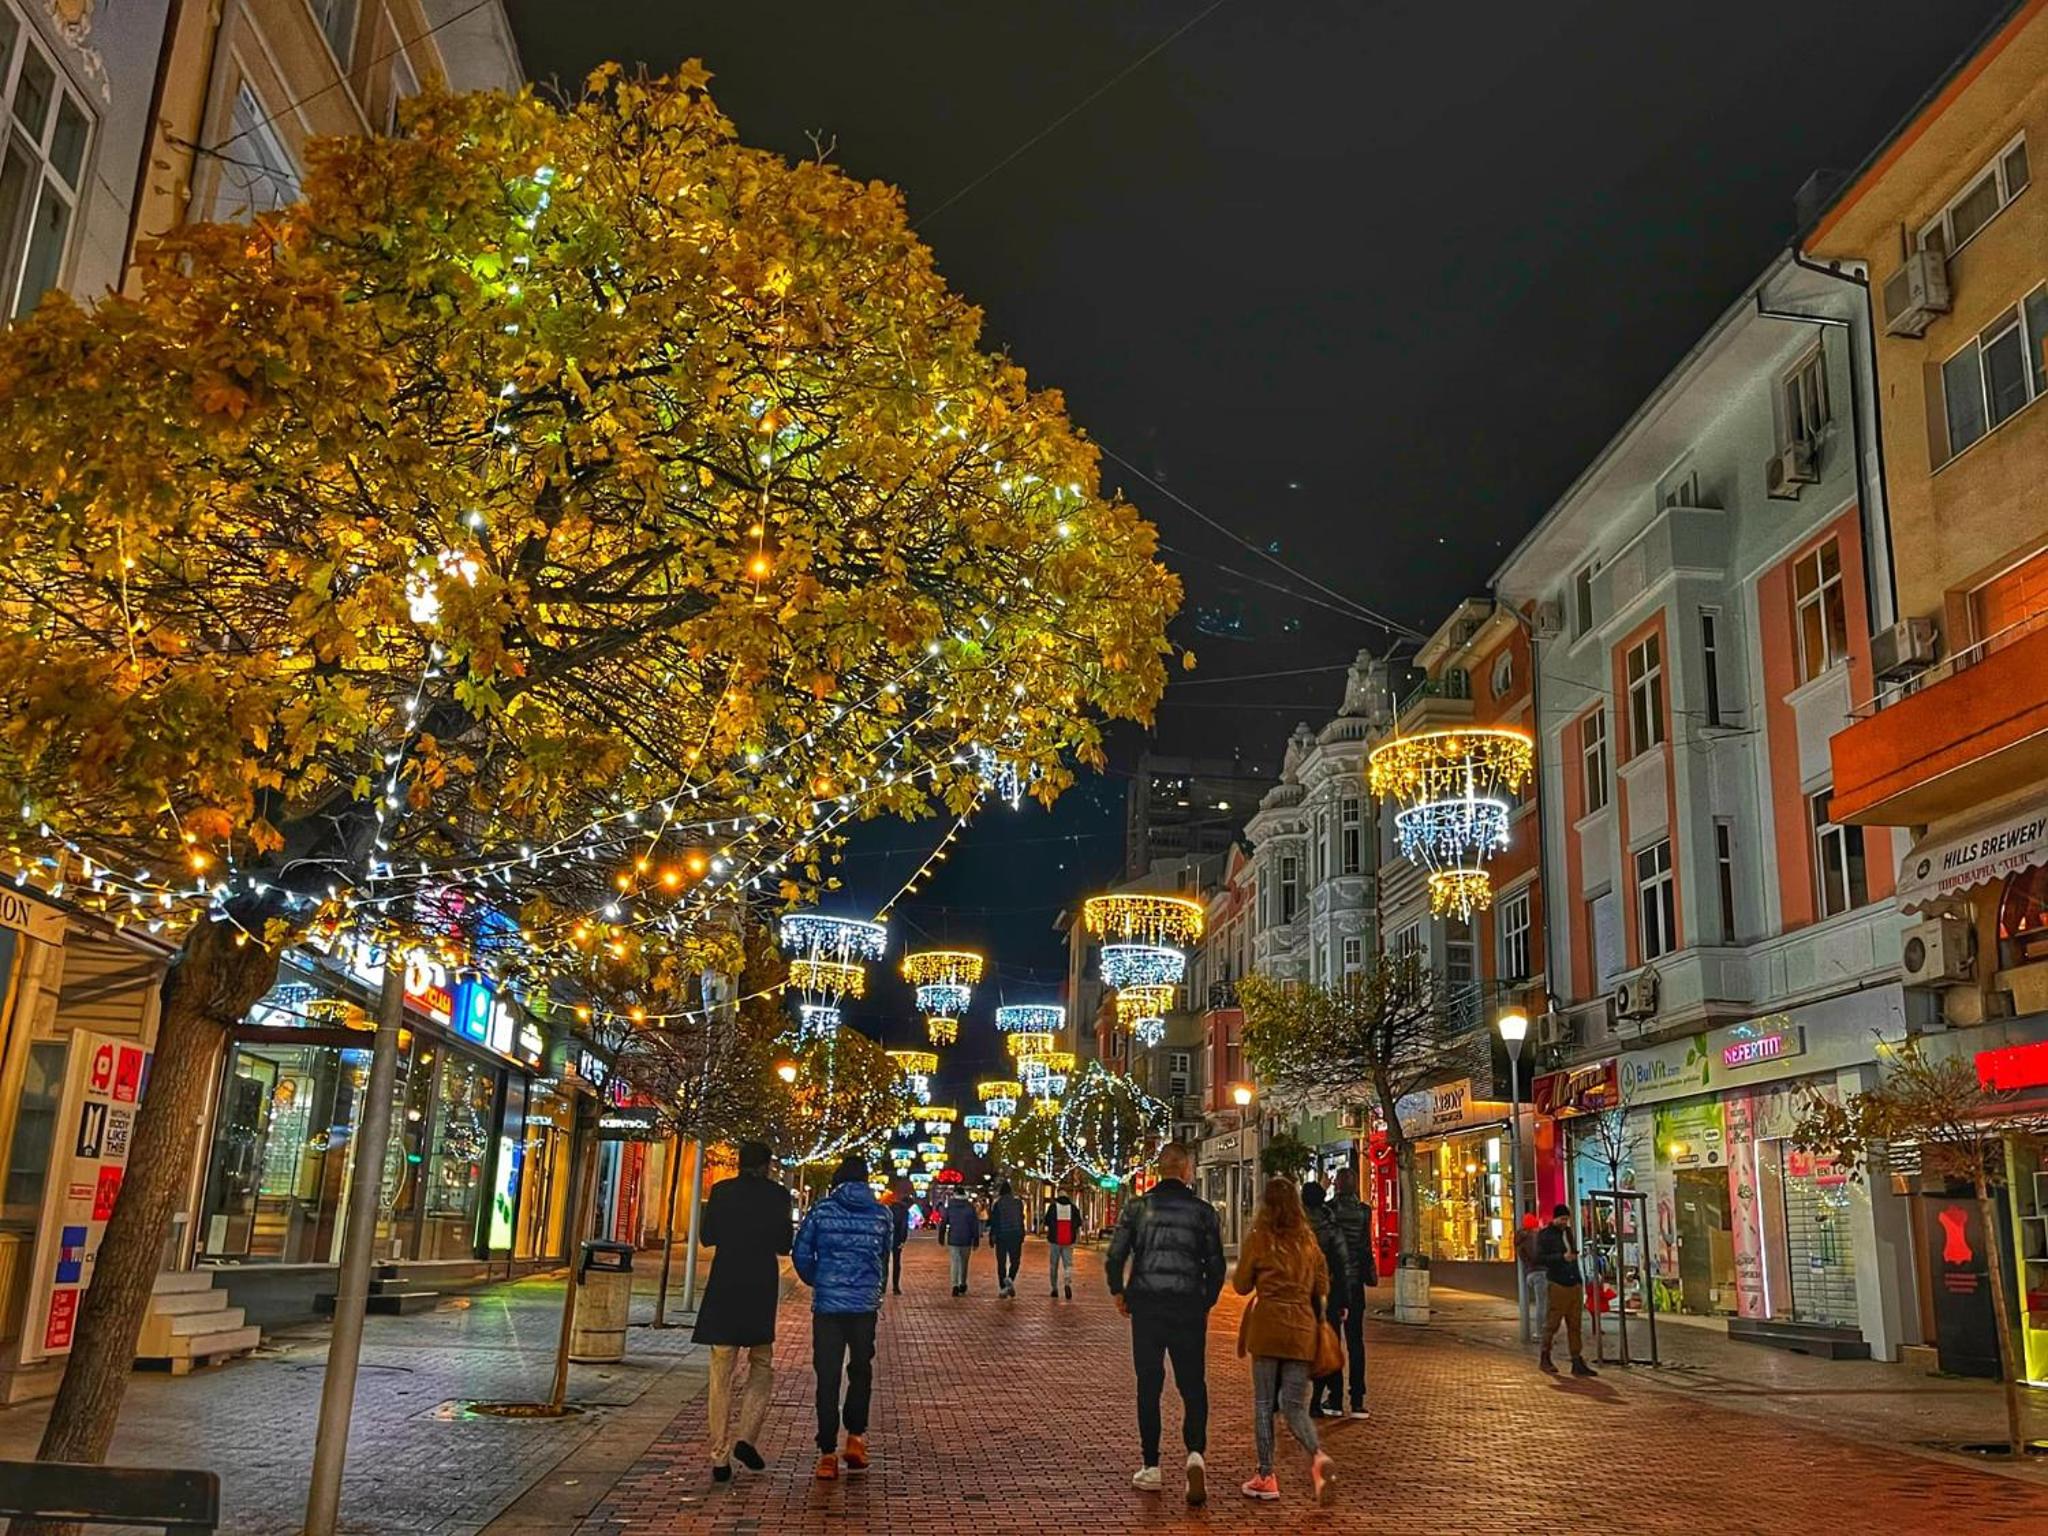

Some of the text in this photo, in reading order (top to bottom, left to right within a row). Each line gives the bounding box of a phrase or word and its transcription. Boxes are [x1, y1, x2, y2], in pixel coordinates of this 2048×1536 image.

[1943, 817, 2047, 870] HILLS BREWERY
[0, 893, 32, 928] ON
[106, 1141, 126, 1154] THIS
[107, 1129, 128, 1142] LIKE
